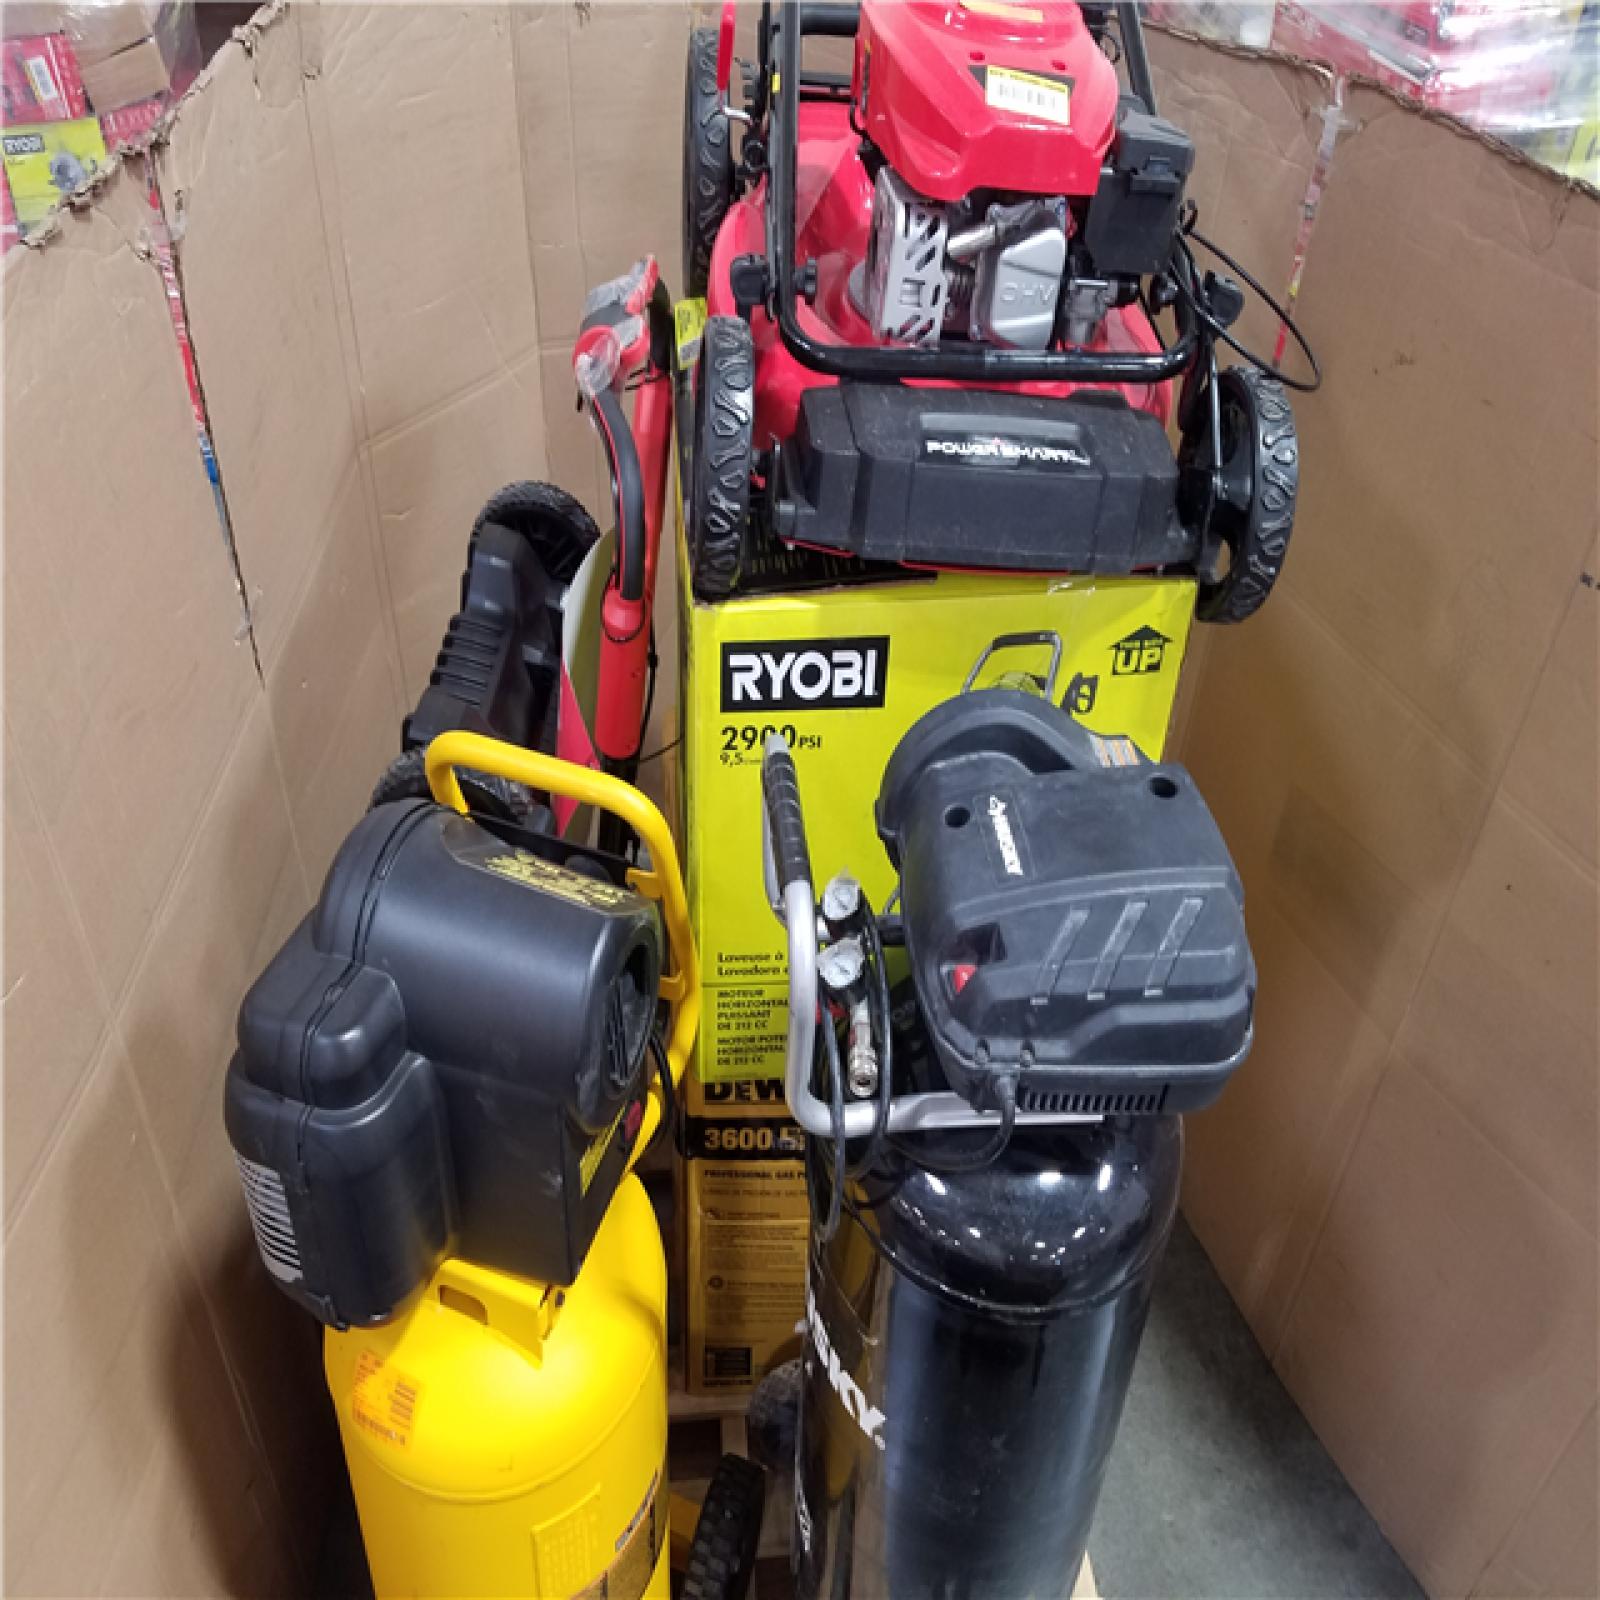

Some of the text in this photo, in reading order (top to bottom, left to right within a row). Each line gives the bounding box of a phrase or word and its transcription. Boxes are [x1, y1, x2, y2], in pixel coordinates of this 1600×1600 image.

[1115, 648, 1162, 674] UP
[728, 649, 879, 702] RYOBI
[704, 1126, 773, 1151] 3600
